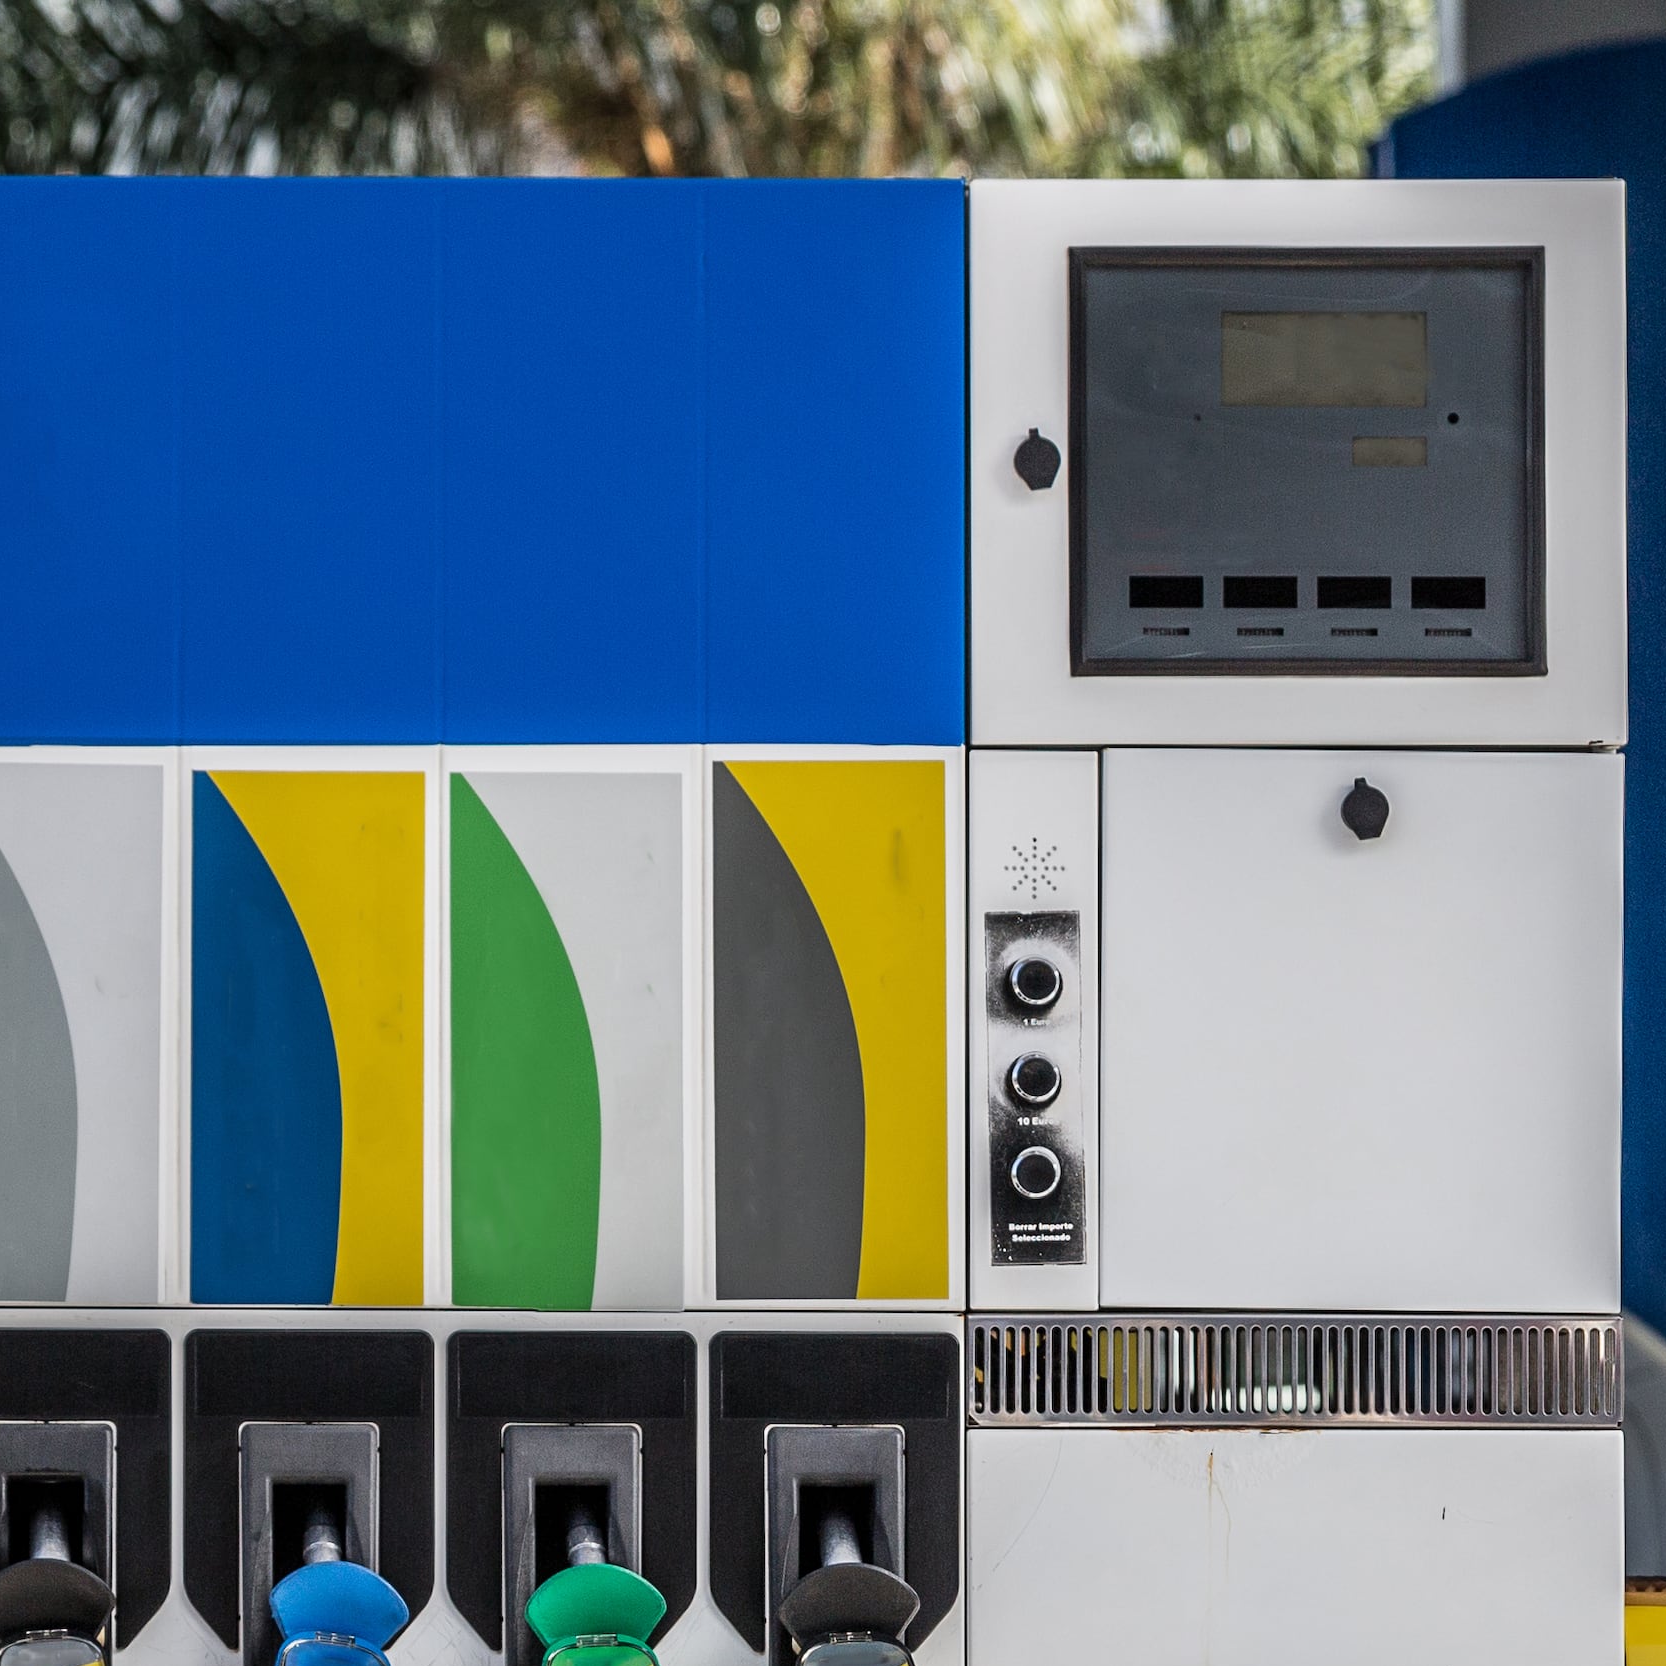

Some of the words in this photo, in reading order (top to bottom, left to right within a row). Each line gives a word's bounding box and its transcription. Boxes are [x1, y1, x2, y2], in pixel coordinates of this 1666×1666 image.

[1017, 1117, 1030, 1126] 10
[1008, 1223, 1037, 1231] Borrar
[1038, 1222, 1074, 1232] Importe
[1012, 1233, 1071, 1242] Seleccionado
